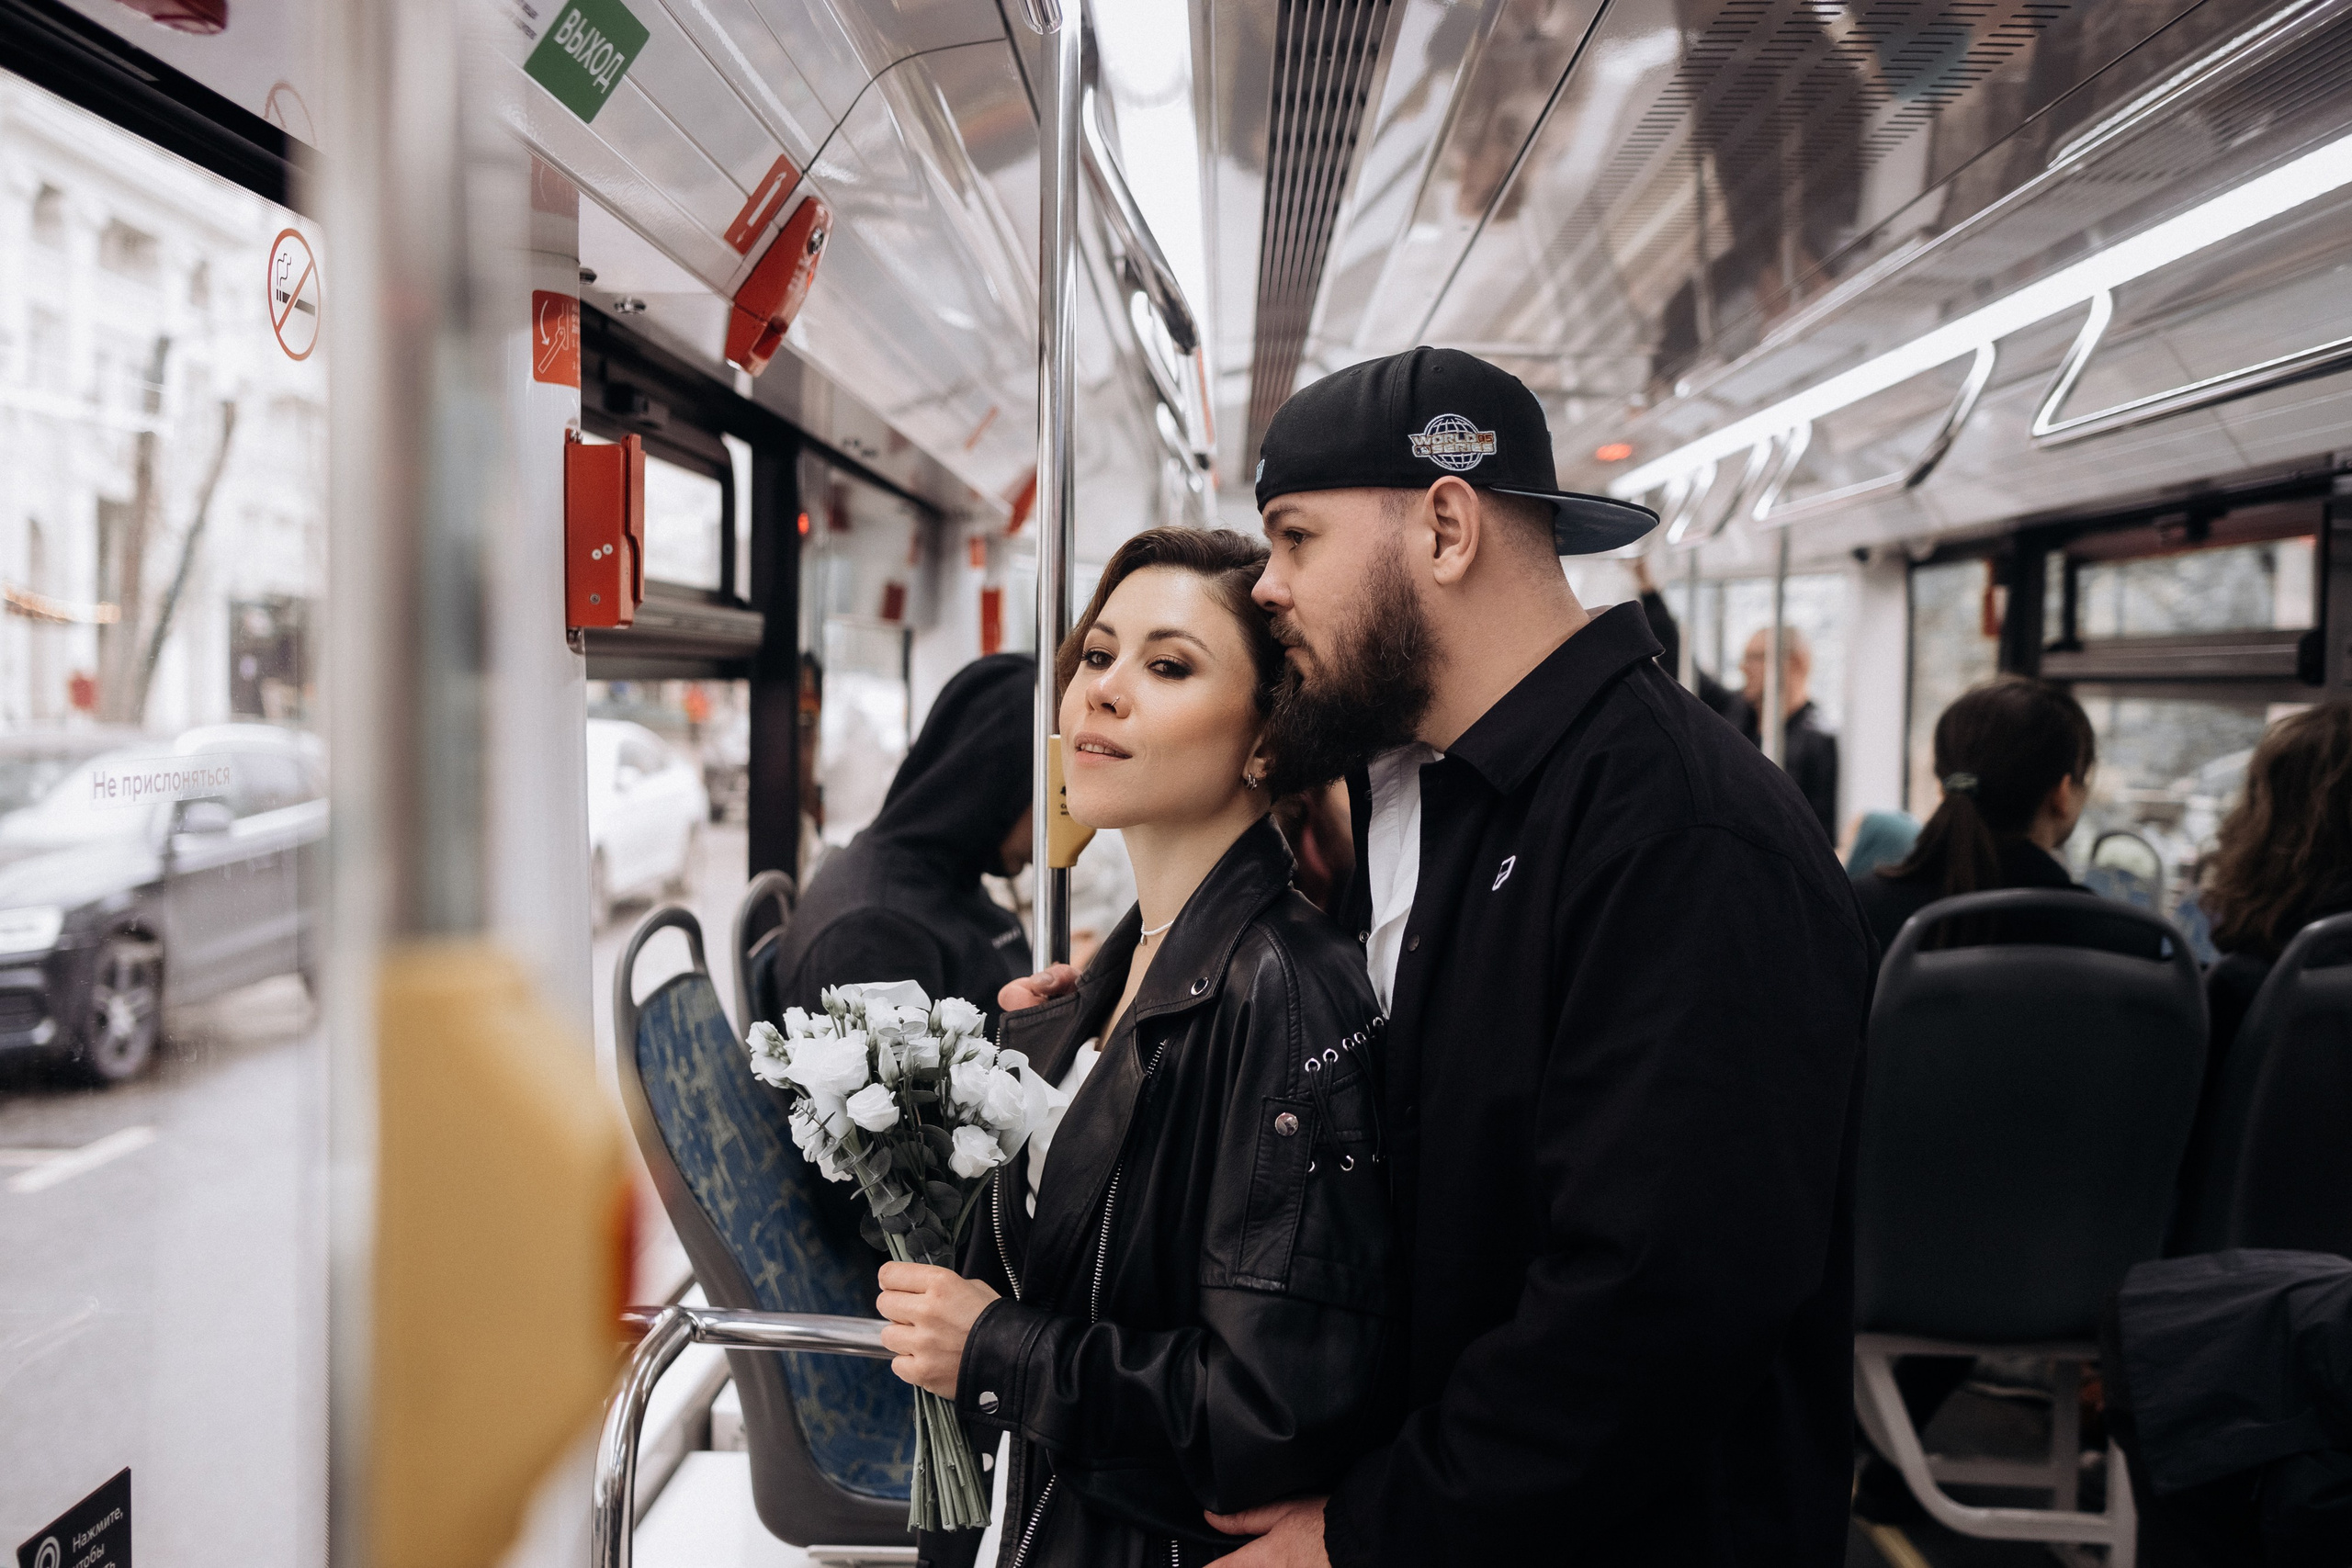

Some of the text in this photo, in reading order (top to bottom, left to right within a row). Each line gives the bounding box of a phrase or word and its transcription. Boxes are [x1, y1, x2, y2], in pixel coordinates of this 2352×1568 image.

[553, 7, 626, 94] ВЫХОД
[1412, 433, 1477, 446] WORLD
[1431, 443, 1494, 454] SERIES
[94, 767, 231, 802] Не прислоняться
[73, 1507, 123, 1553] Нажмите,
